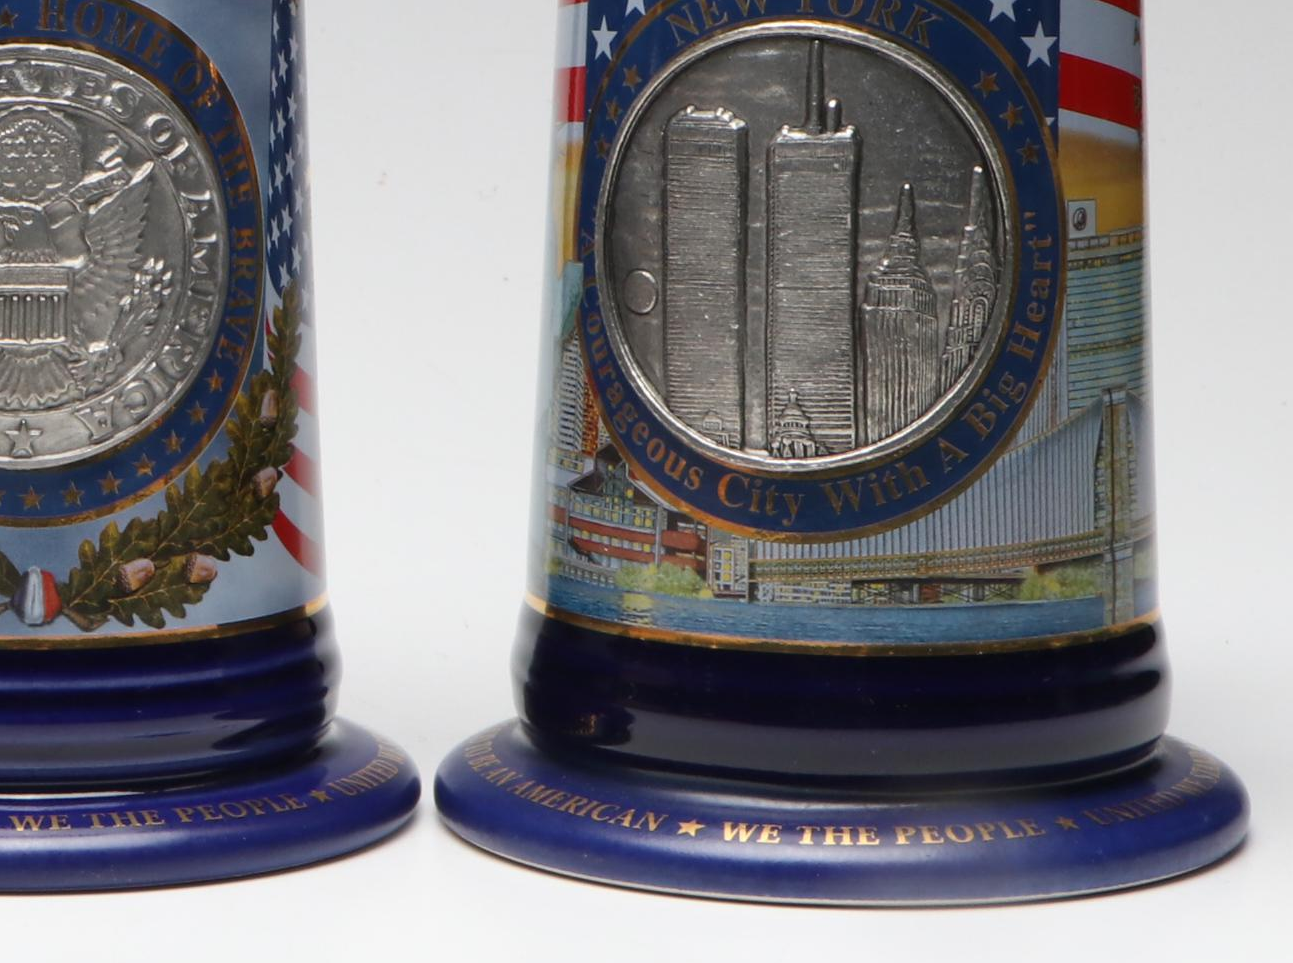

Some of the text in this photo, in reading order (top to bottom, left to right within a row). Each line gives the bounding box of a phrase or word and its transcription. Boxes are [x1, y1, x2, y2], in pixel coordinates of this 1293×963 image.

[173, 59, 223, 109] OF
[146, 112, 207, 175] OF
[209, 119, 254, 209] THE
[76, 189, 219, 441] AMERICA
[215, 227, 256, 362] BRAVE
[581, 275, 705, 491] Courageous
[716, 473, 807, 527] City
[822, 457, 930, 517] With
[936, 440, 970, 474] A
[974, 375, 1030, 431] Big
[9, 813, 72, 833] WE
[82, 808, 166, 830] THE
[173, 792, 309, 824] PEOPLE
[325, 759, 400, 796] UNITED
[505, 779, 669, 833] AMERICAN
[721, 821, 783, 845] WE
[796, 825, 881, 846] THE
[892, 817, 1048, 846] PEOPLE
